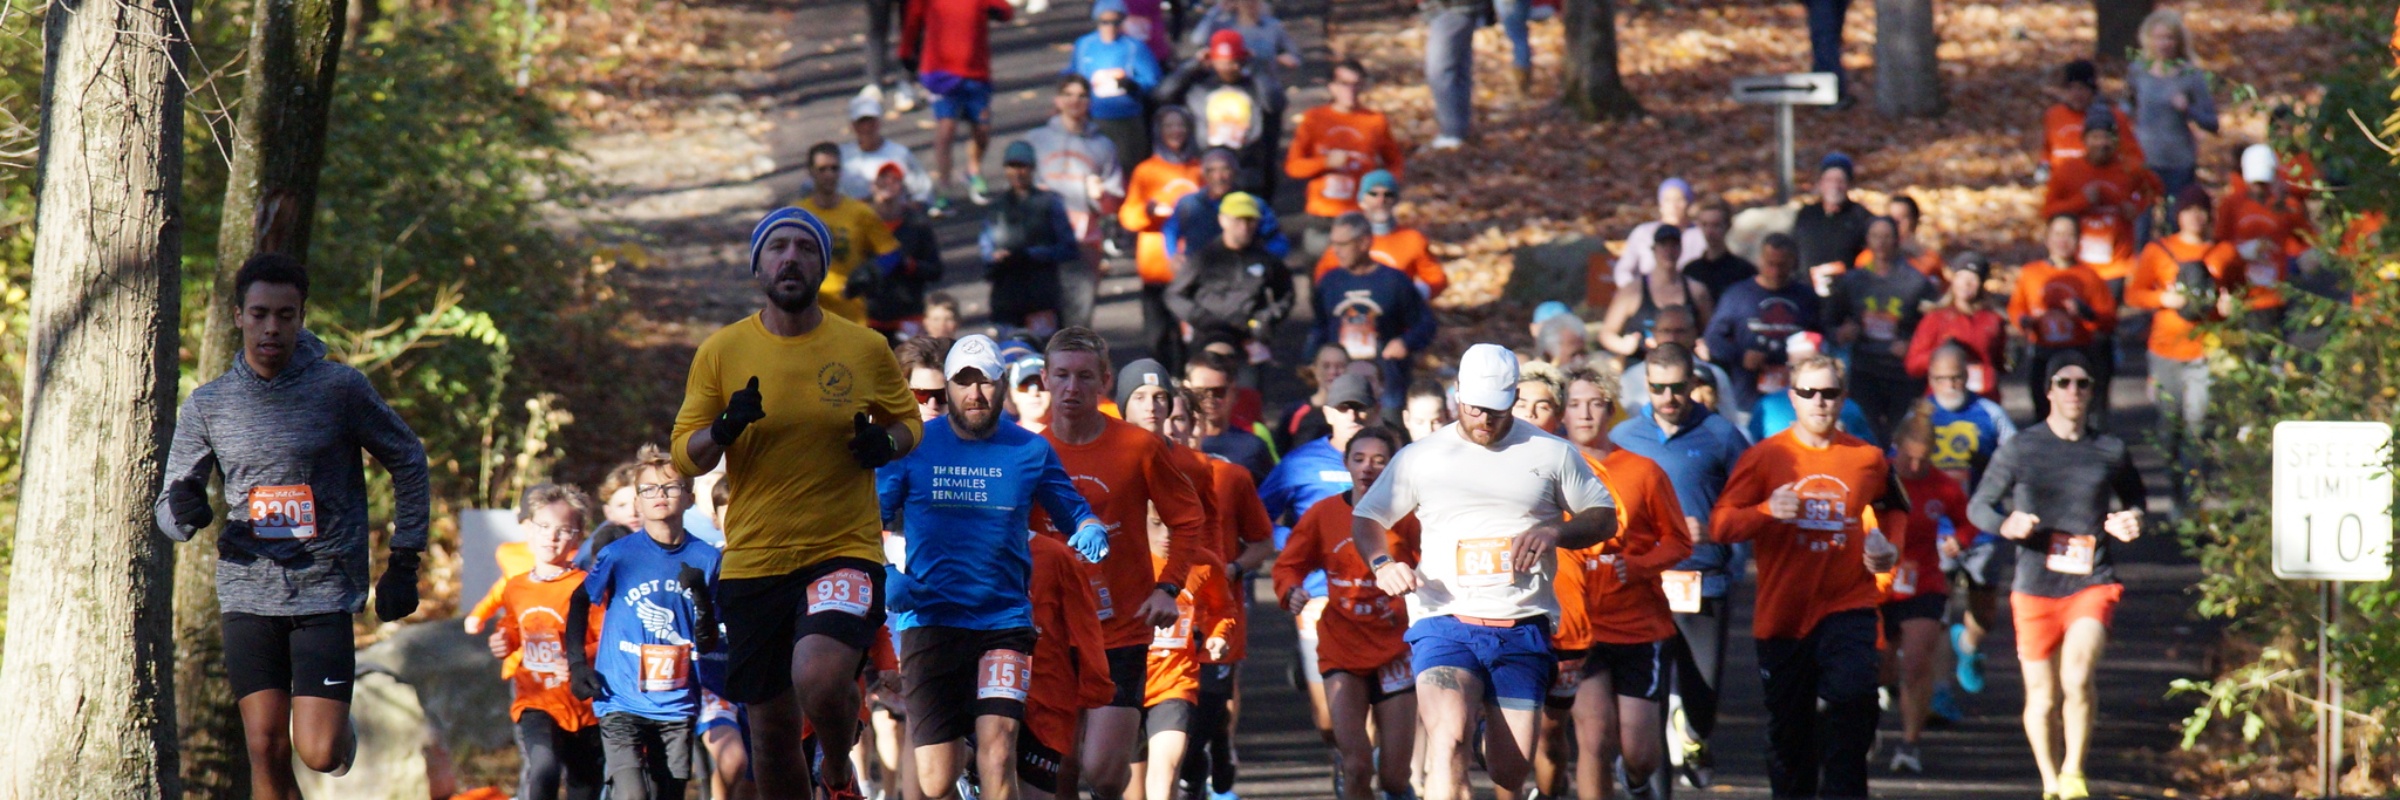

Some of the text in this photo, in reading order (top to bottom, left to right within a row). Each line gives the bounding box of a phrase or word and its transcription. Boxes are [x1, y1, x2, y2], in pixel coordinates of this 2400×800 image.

[2297, 475, 2363, 500] LIMIT
[252, 500, 301, 527] 330
[1805, 499, 1830, 520] 99
[2304, 513, 2362, 563] 10
[1464, 550, 1495, 575] 64
[624, 579, 660, 607] LOST
[817, 580, 850, 601] 93
[647, 657, 675, 680] 74
[988, 663, 1016, 687] 15
